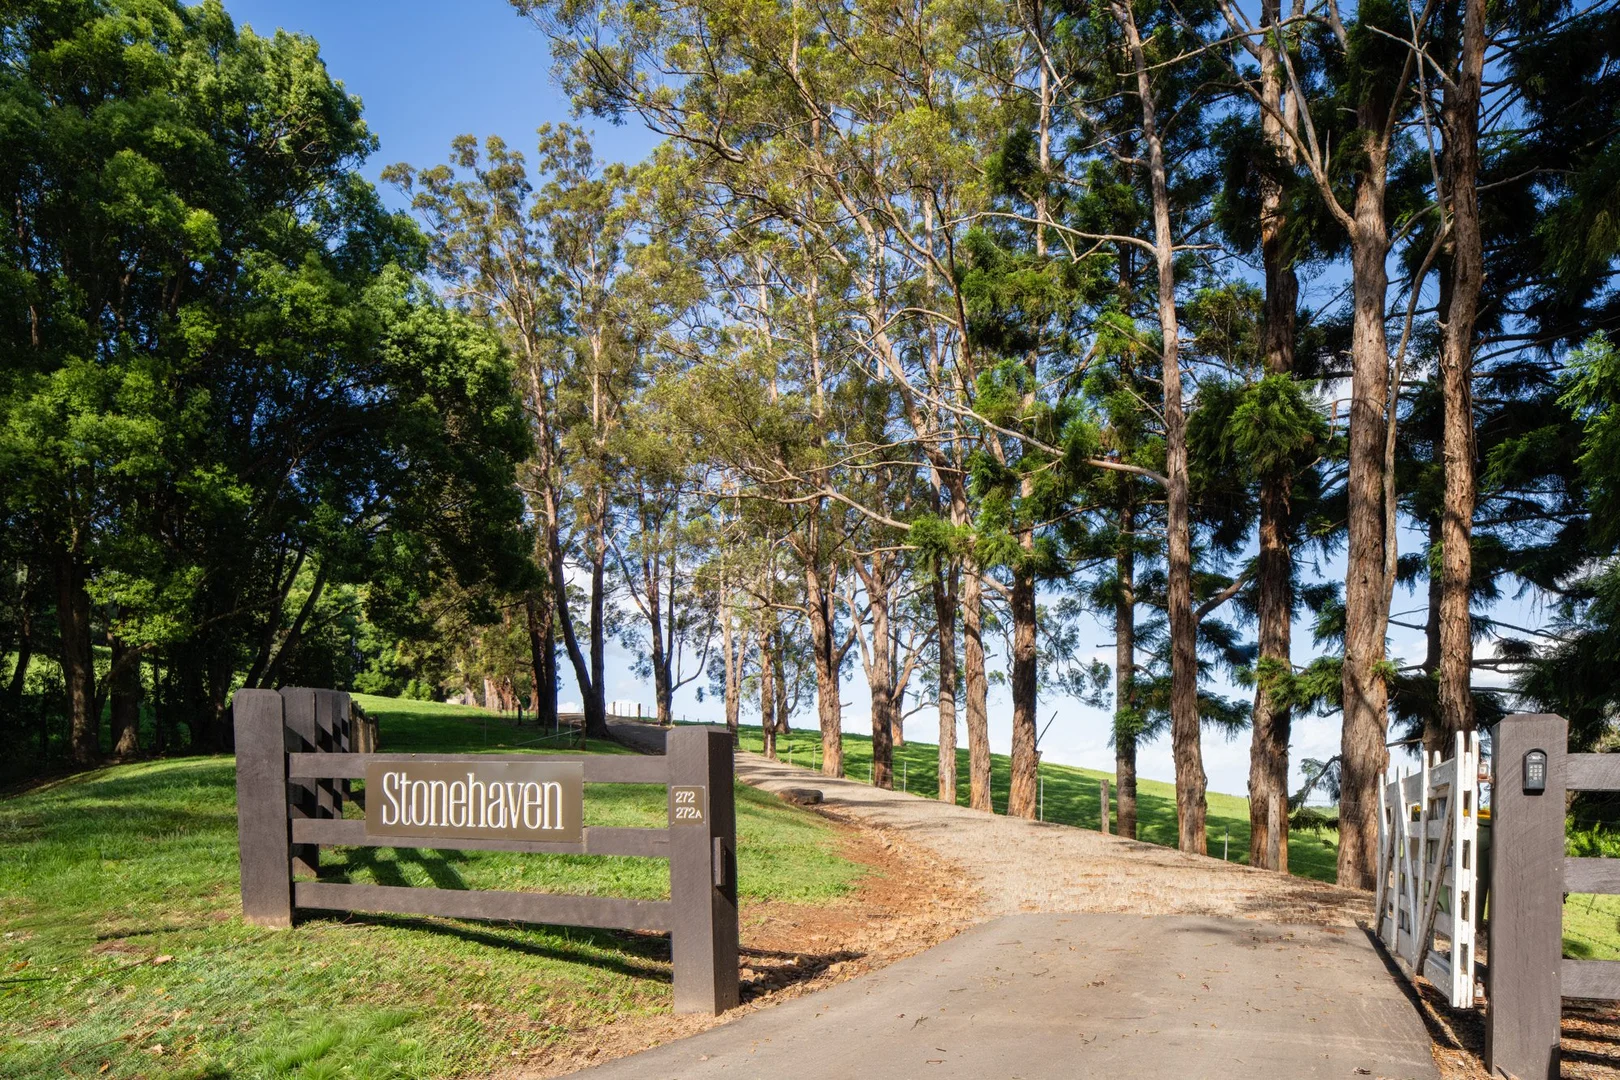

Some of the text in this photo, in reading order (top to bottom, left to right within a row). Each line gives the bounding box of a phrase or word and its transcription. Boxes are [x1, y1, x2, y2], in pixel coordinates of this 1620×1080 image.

[381, 771, 564, 830] Stonehaven
[675, 791, 695, 803] 272
[675, 807, 702, 819] 272A
